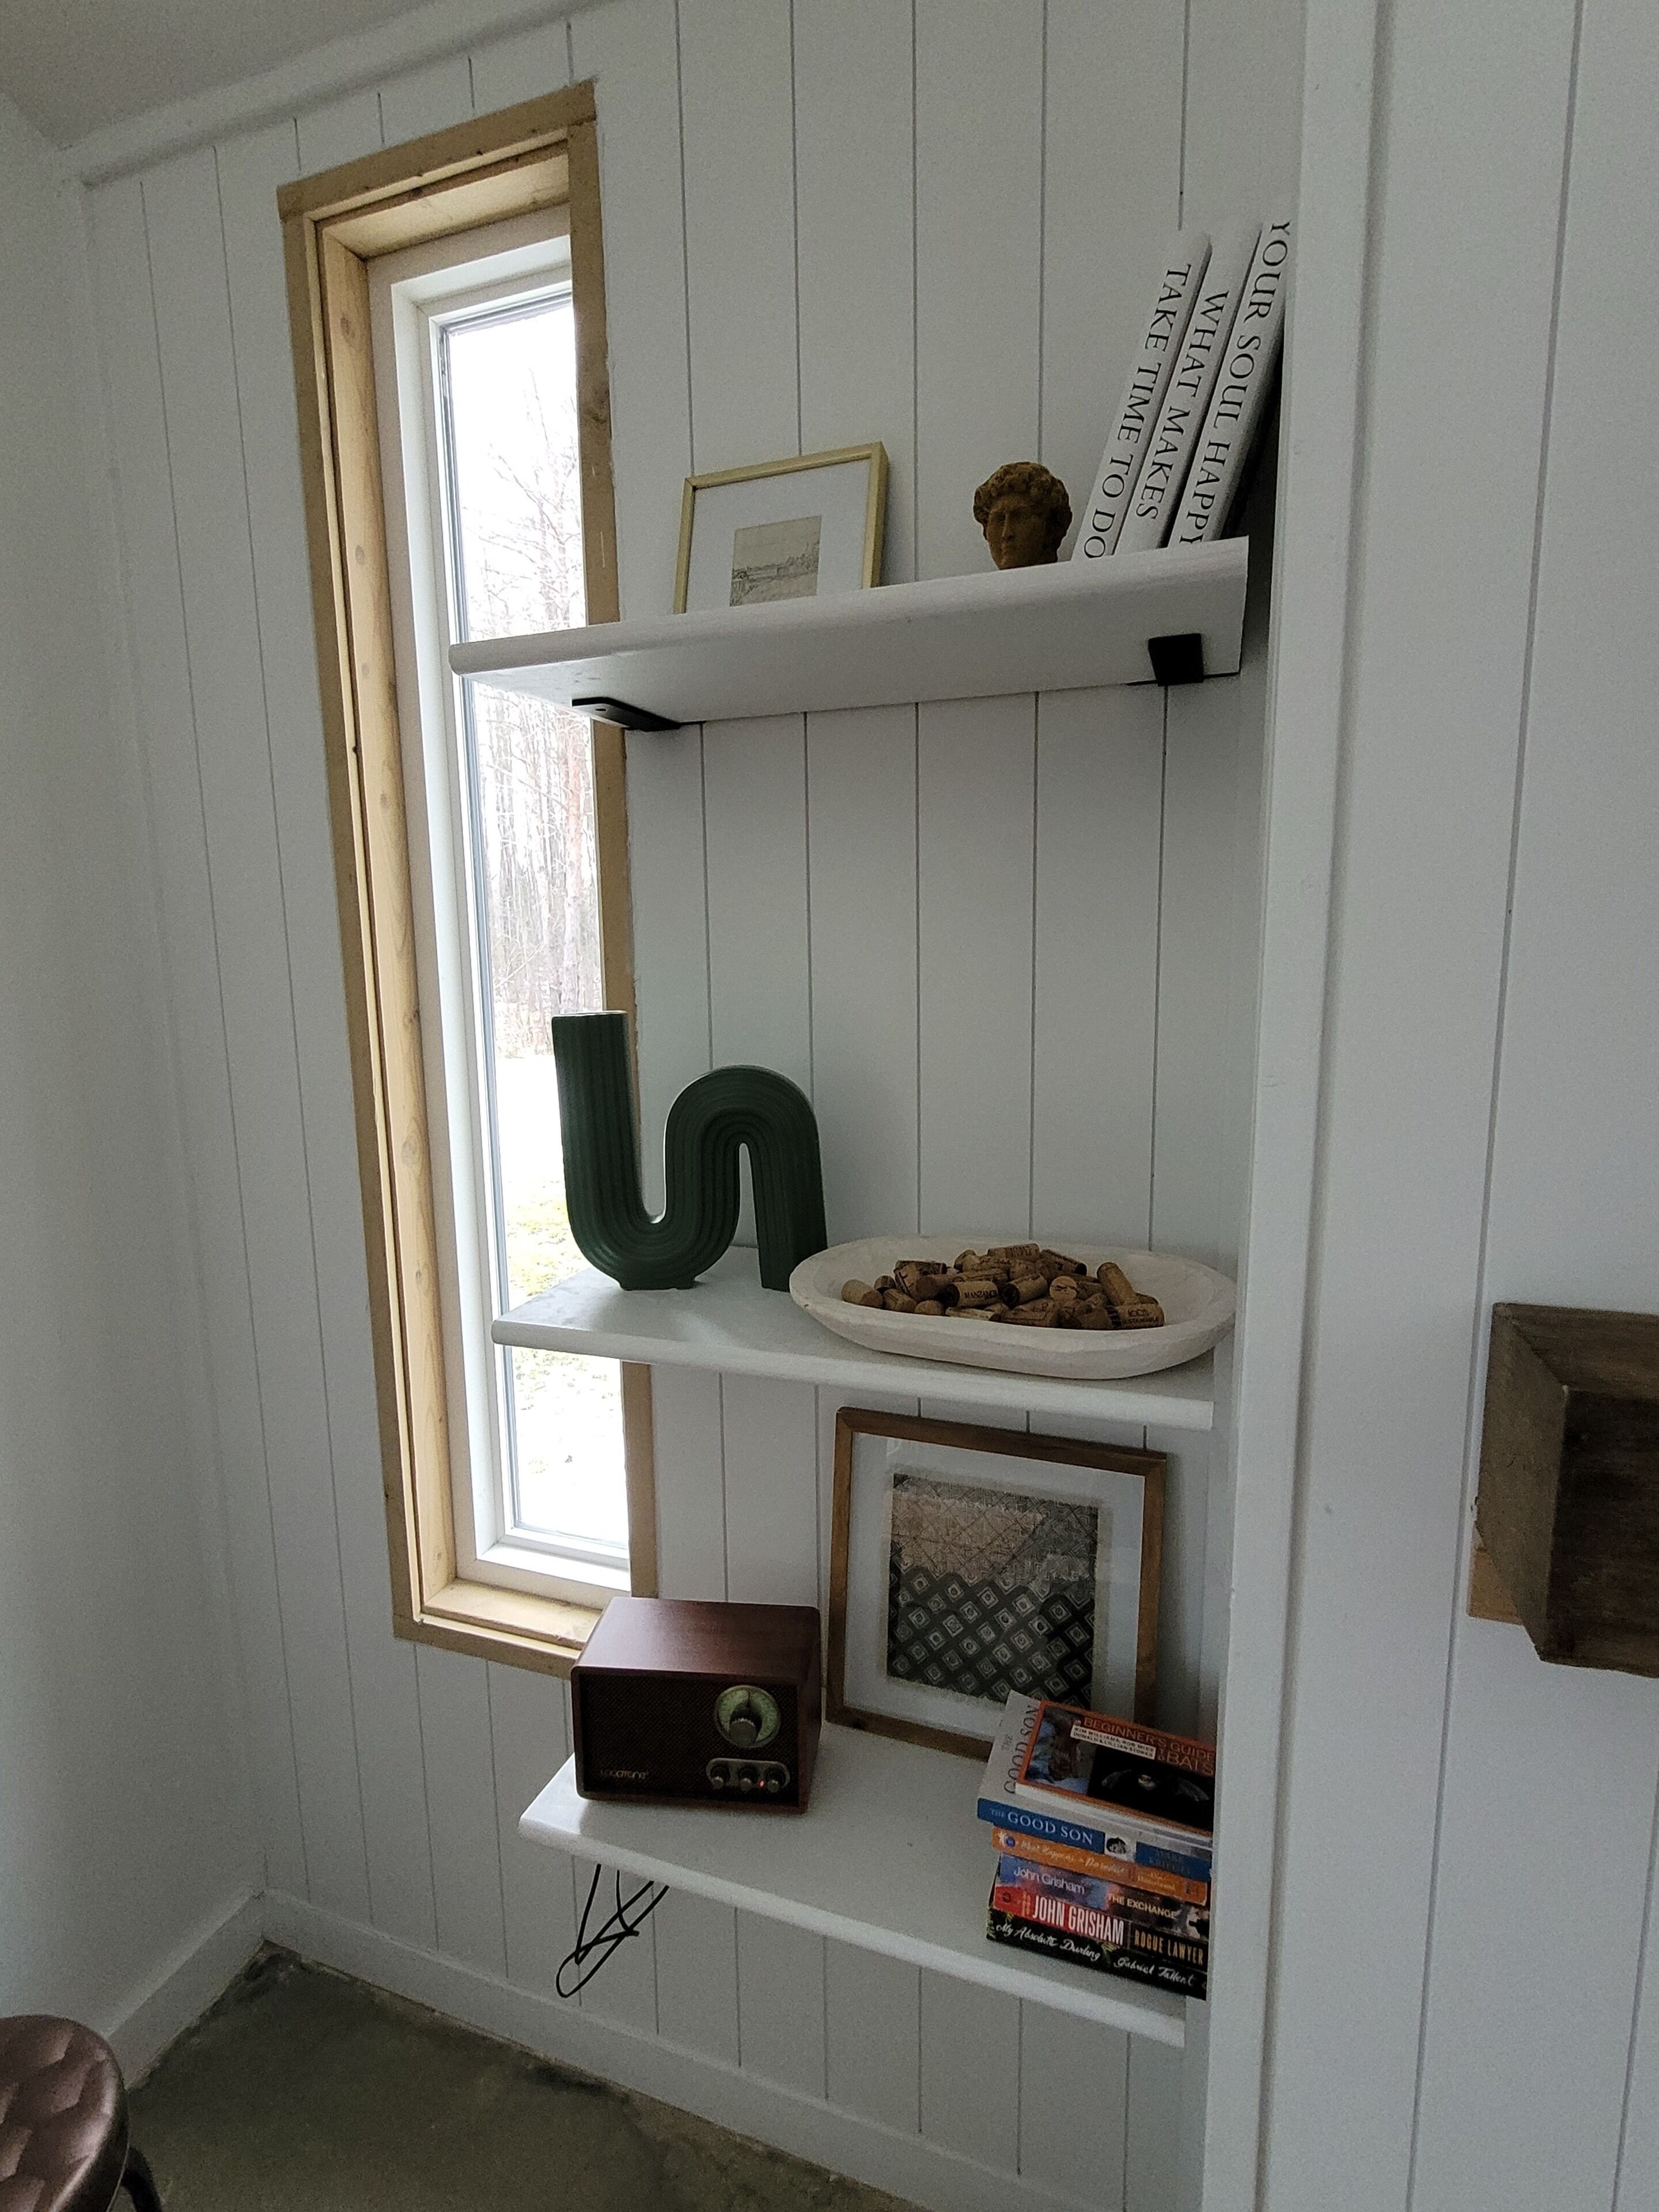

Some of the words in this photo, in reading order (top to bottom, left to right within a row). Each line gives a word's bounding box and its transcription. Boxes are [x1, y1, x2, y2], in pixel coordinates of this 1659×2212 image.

[1244, 221, 1290, 323] YOUR
[1145, 264, 1191, 352] TAKE
[1177, 290, 1229, 397] WHAT
[1118, 363, 1162, 444] TIME
[1214, 335, 1261, 429] SOUL
[1101, 454, 1134, 498] TO
[1136, 406, 1191, 520] MAKES
[1179, 440, 1230, 544] HAPPY
[1084, 508, 1116, 559] DO
[1020, 1705, 1039, 1736] SON
[1084, 1717, 1166, 1748] BEGINNER'S
[1170, 1741, 1214, 1761] GUIDE
[1166, 1751, 1214, 1776] BATS
[990, 1808, 1006, 1819] THE
[1007, 1810, 1056, 1834] GOOD
[1060, 1824, 1093, 1846] SON
[1013, 1866, 1040, 1882] John
[1041, 1874, 1086, 1895] Grisham
[1032, 1895, 1065, 1927] JOHN
[1068, 1906, 1124, 1946] GRISHAM
[1107, 1893, 1126, 1906] THE
[1127, 1896, 1177, 1919] EXCHANGE
[995, 1923, 1013, 1938] My
[1013, 1926, 1059, 1948] Absolute
[1059, 1938, 1101, 1962] Darling
[1134, 1929, 1164, 1955] ROGUE
[1167, 1938, 1204, 1966] LAWYER
[1112, 1956, 1156, 1976] Gabriel
[1157, 1965, 1198, 1987] Tallent
